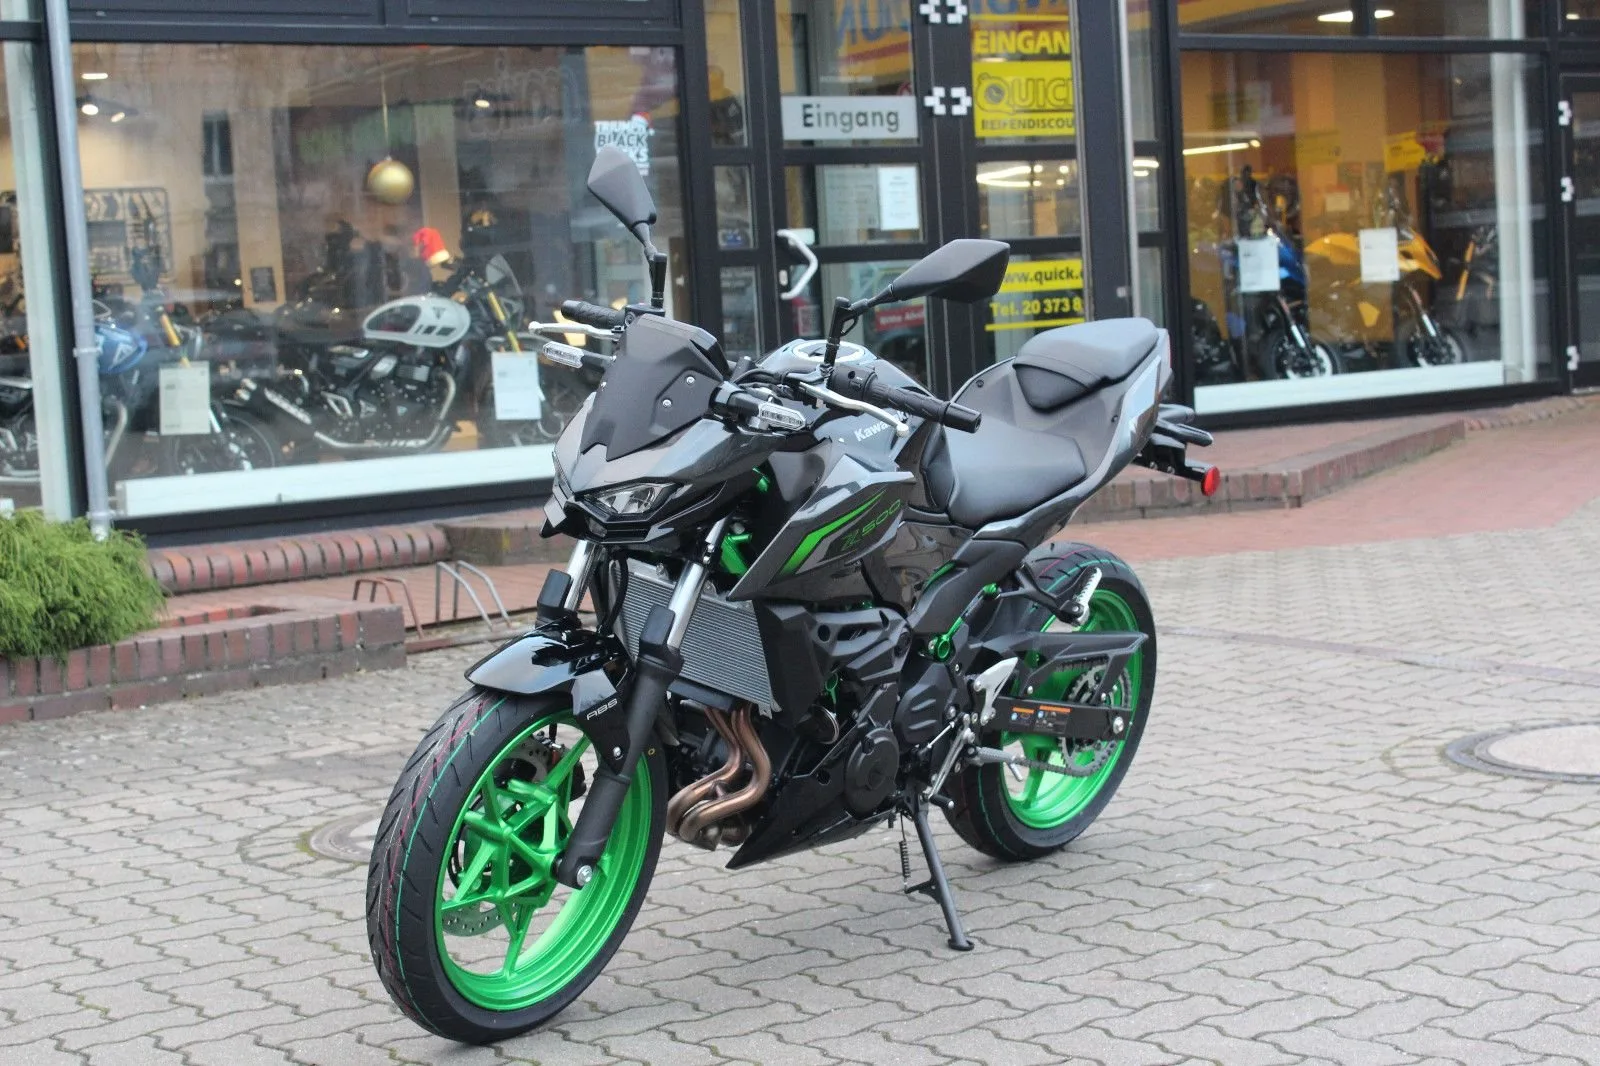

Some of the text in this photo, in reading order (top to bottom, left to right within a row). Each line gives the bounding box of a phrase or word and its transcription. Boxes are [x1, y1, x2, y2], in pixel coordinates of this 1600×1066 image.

[975, 71, 1074, 115] QUIC
[802, 103, 899, 133] Eingang
[1022, 299, 1041, 316] 20
[586, 698, 618, 721] ABS
